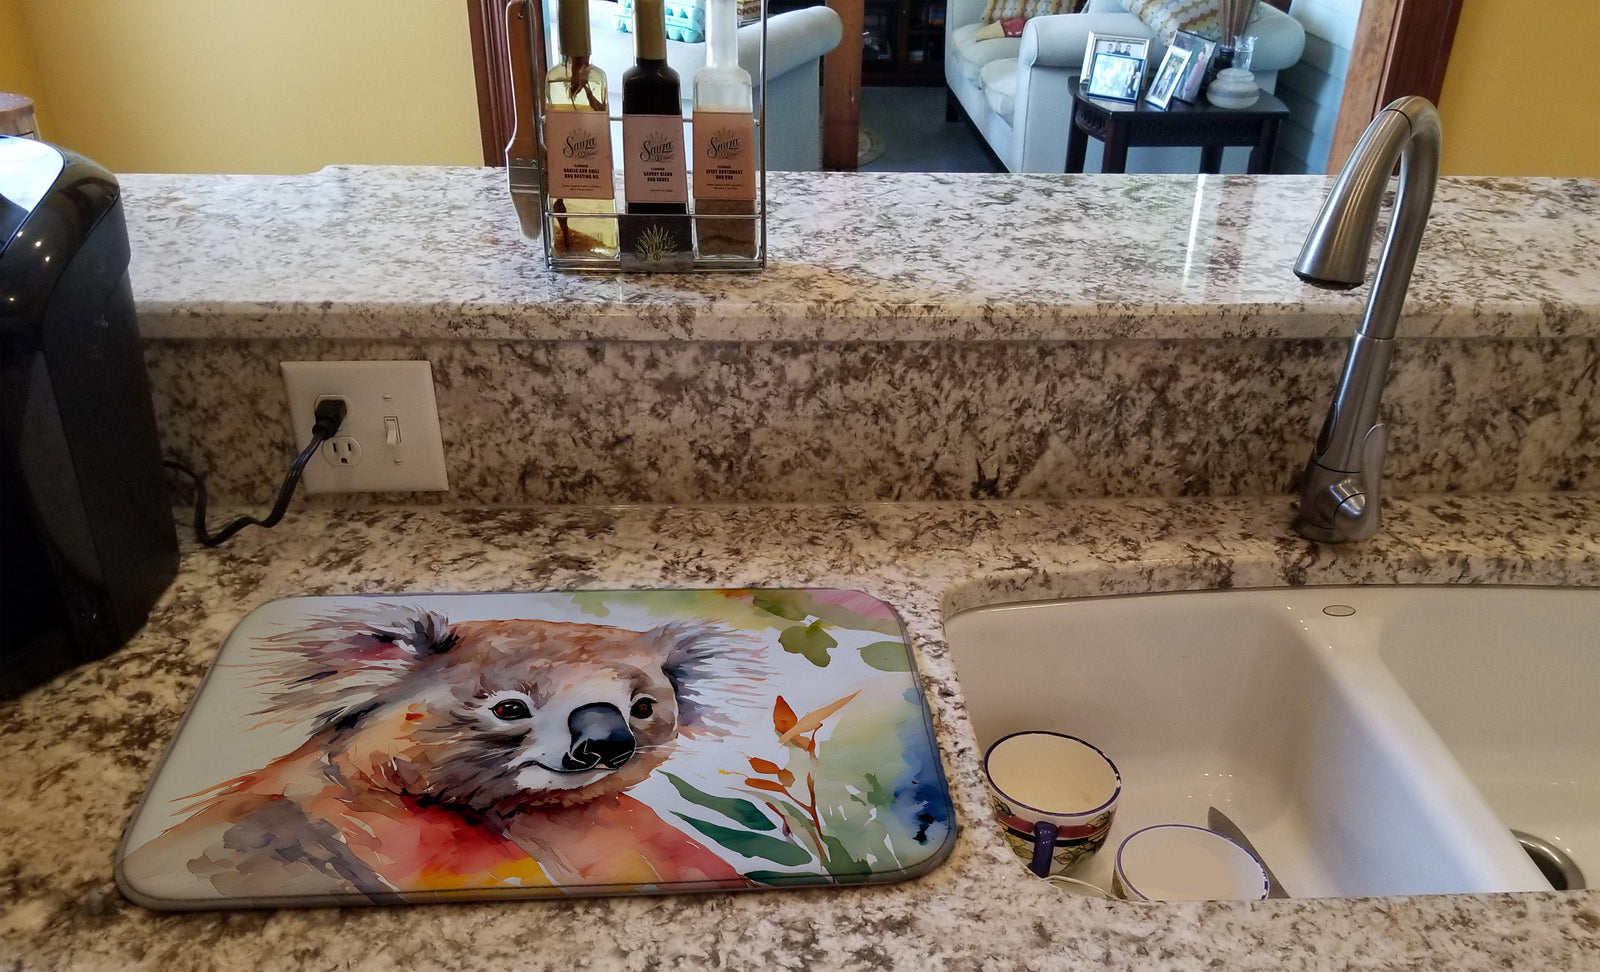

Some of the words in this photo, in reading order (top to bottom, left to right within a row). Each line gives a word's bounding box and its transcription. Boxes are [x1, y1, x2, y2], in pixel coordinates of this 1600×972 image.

[562, 136, 597, 158] Sauza
[640, 140, 674, 162] Sauza
[707, 136, 739, 159] Sauza
